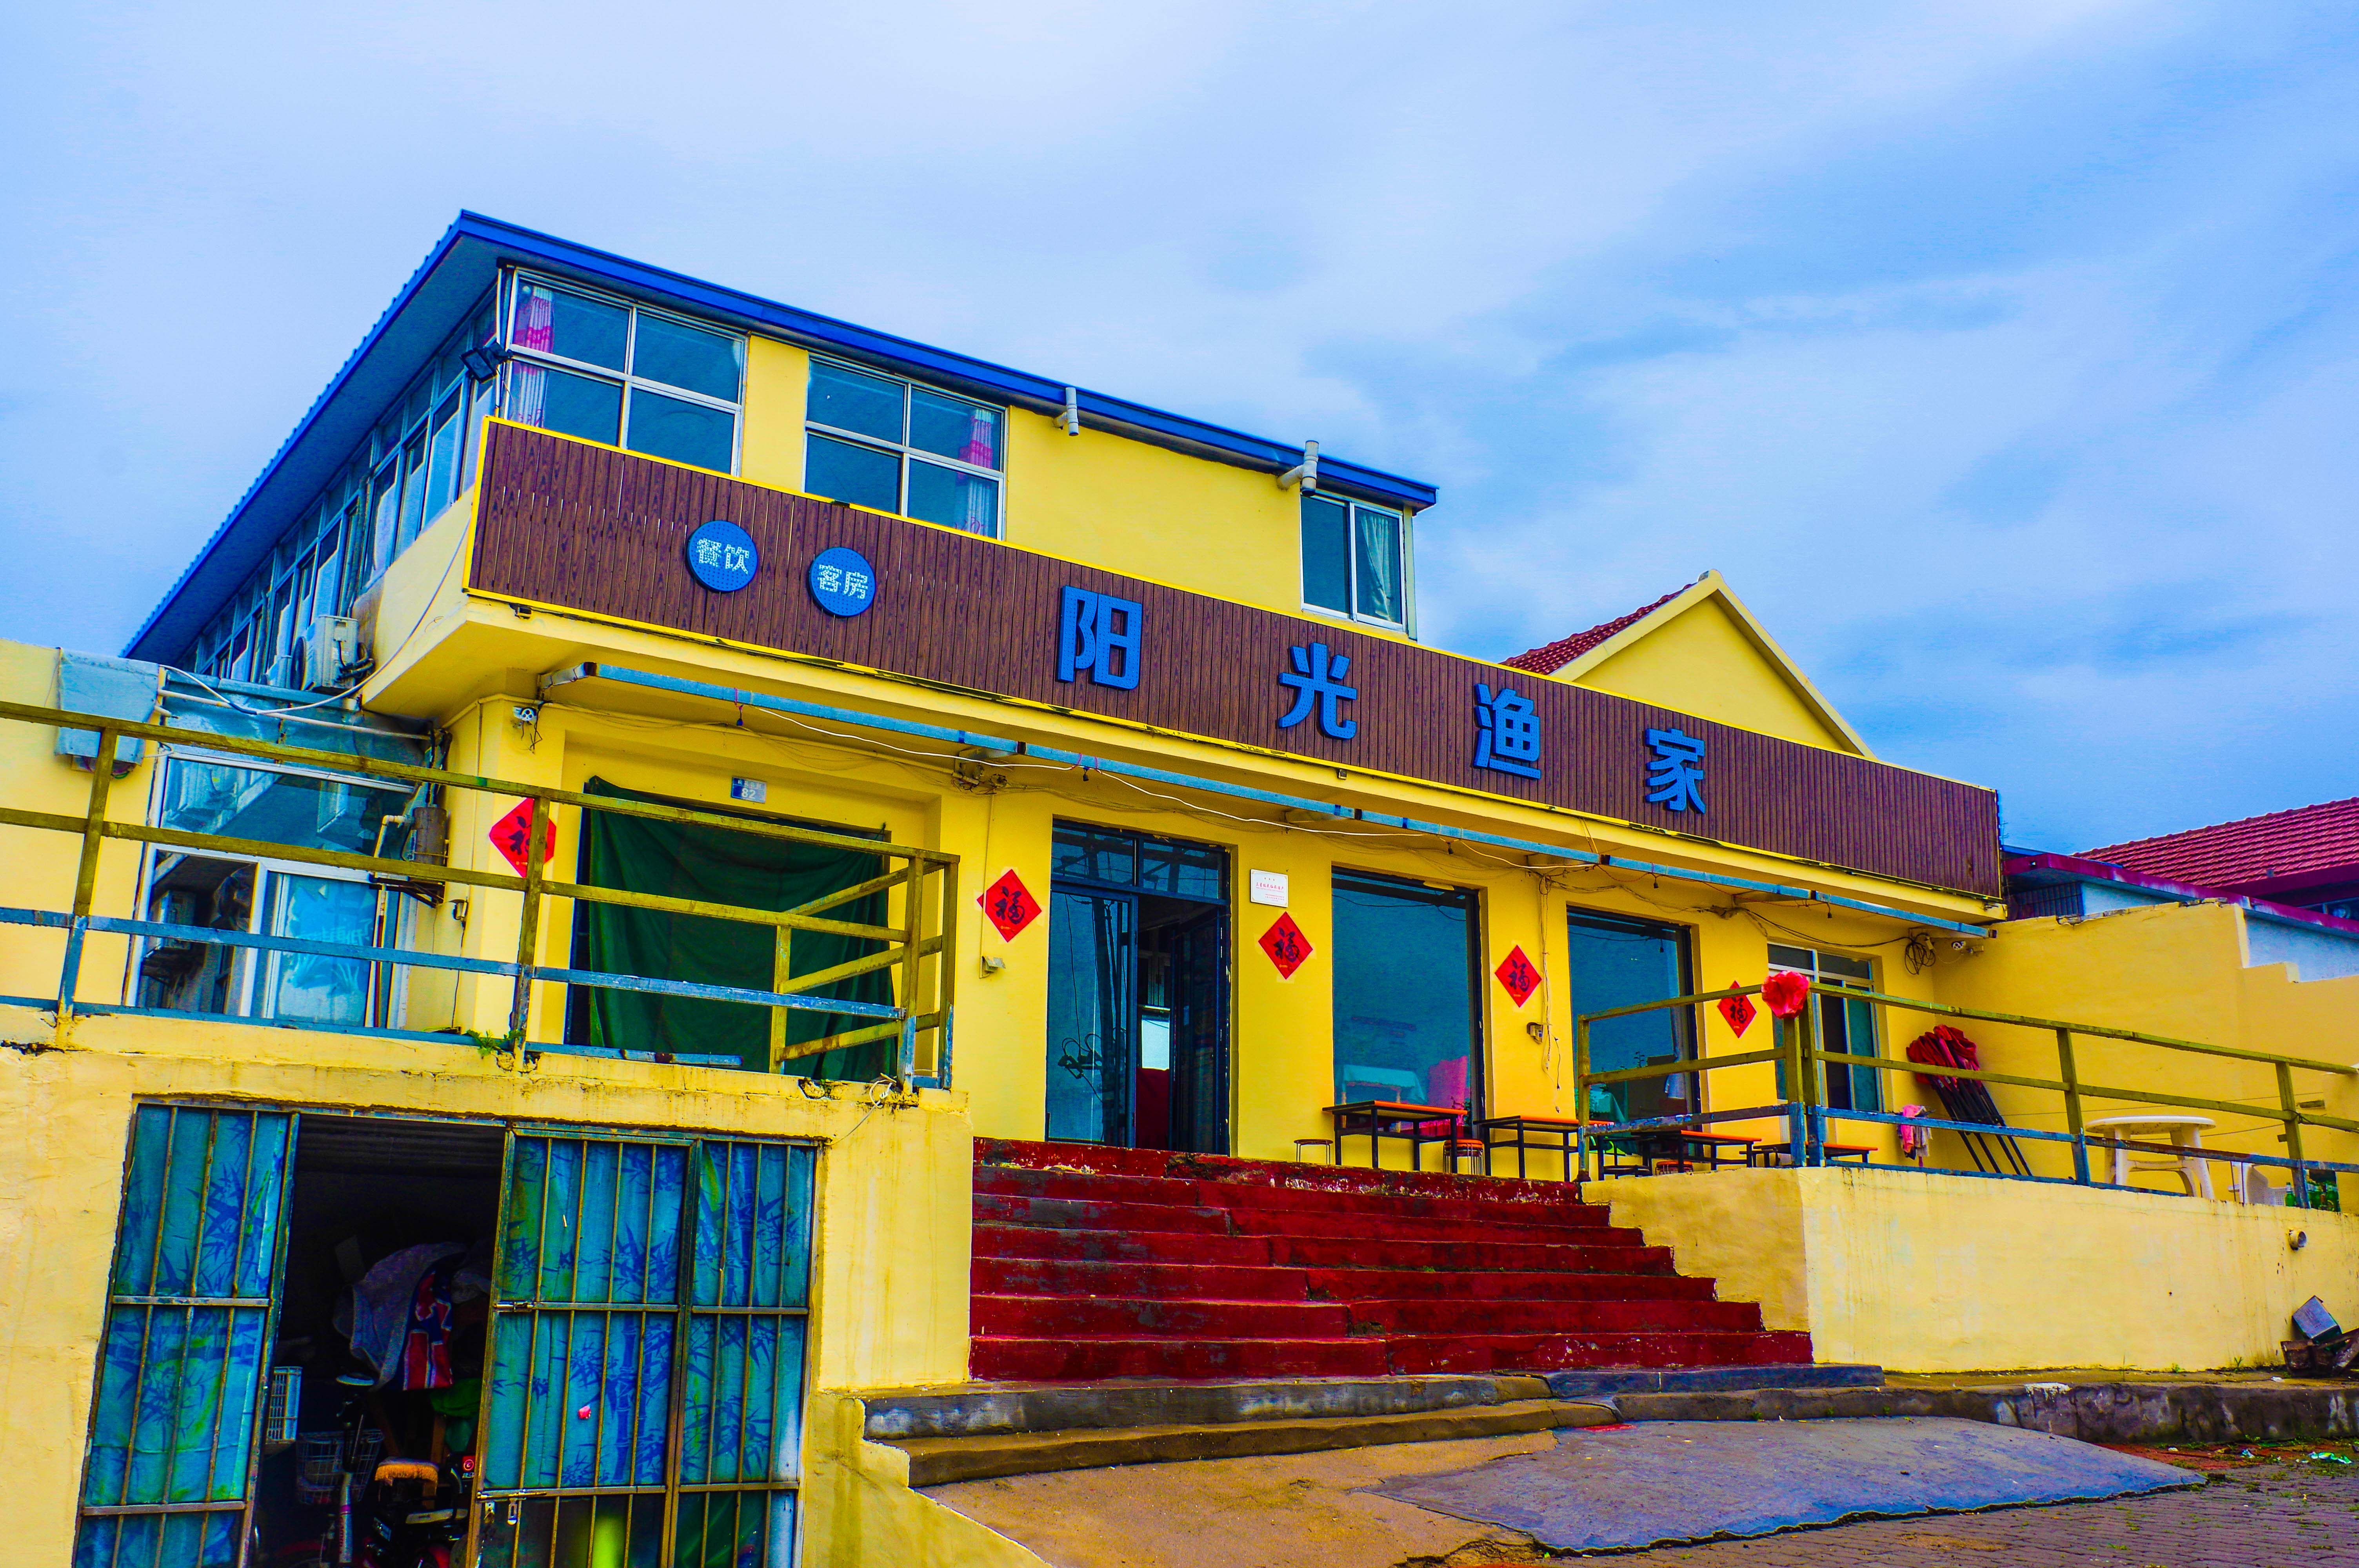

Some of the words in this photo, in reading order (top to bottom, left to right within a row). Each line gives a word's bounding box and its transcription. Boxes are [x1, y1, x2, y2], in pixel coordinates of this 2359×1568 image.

[697, 538, 750, 574] 餐饮
[817, 564, 868, 599] 客房
[1056, 585, 1706, 814] 阳光渔家
[742, 788, 756, 799] 82
[994, 886, 1025, 924] 福
[1274, 927, 1300, 962] 福
[1508, 960, 1530, 992] 福
[1728, 997, 1748, 1024] 福
